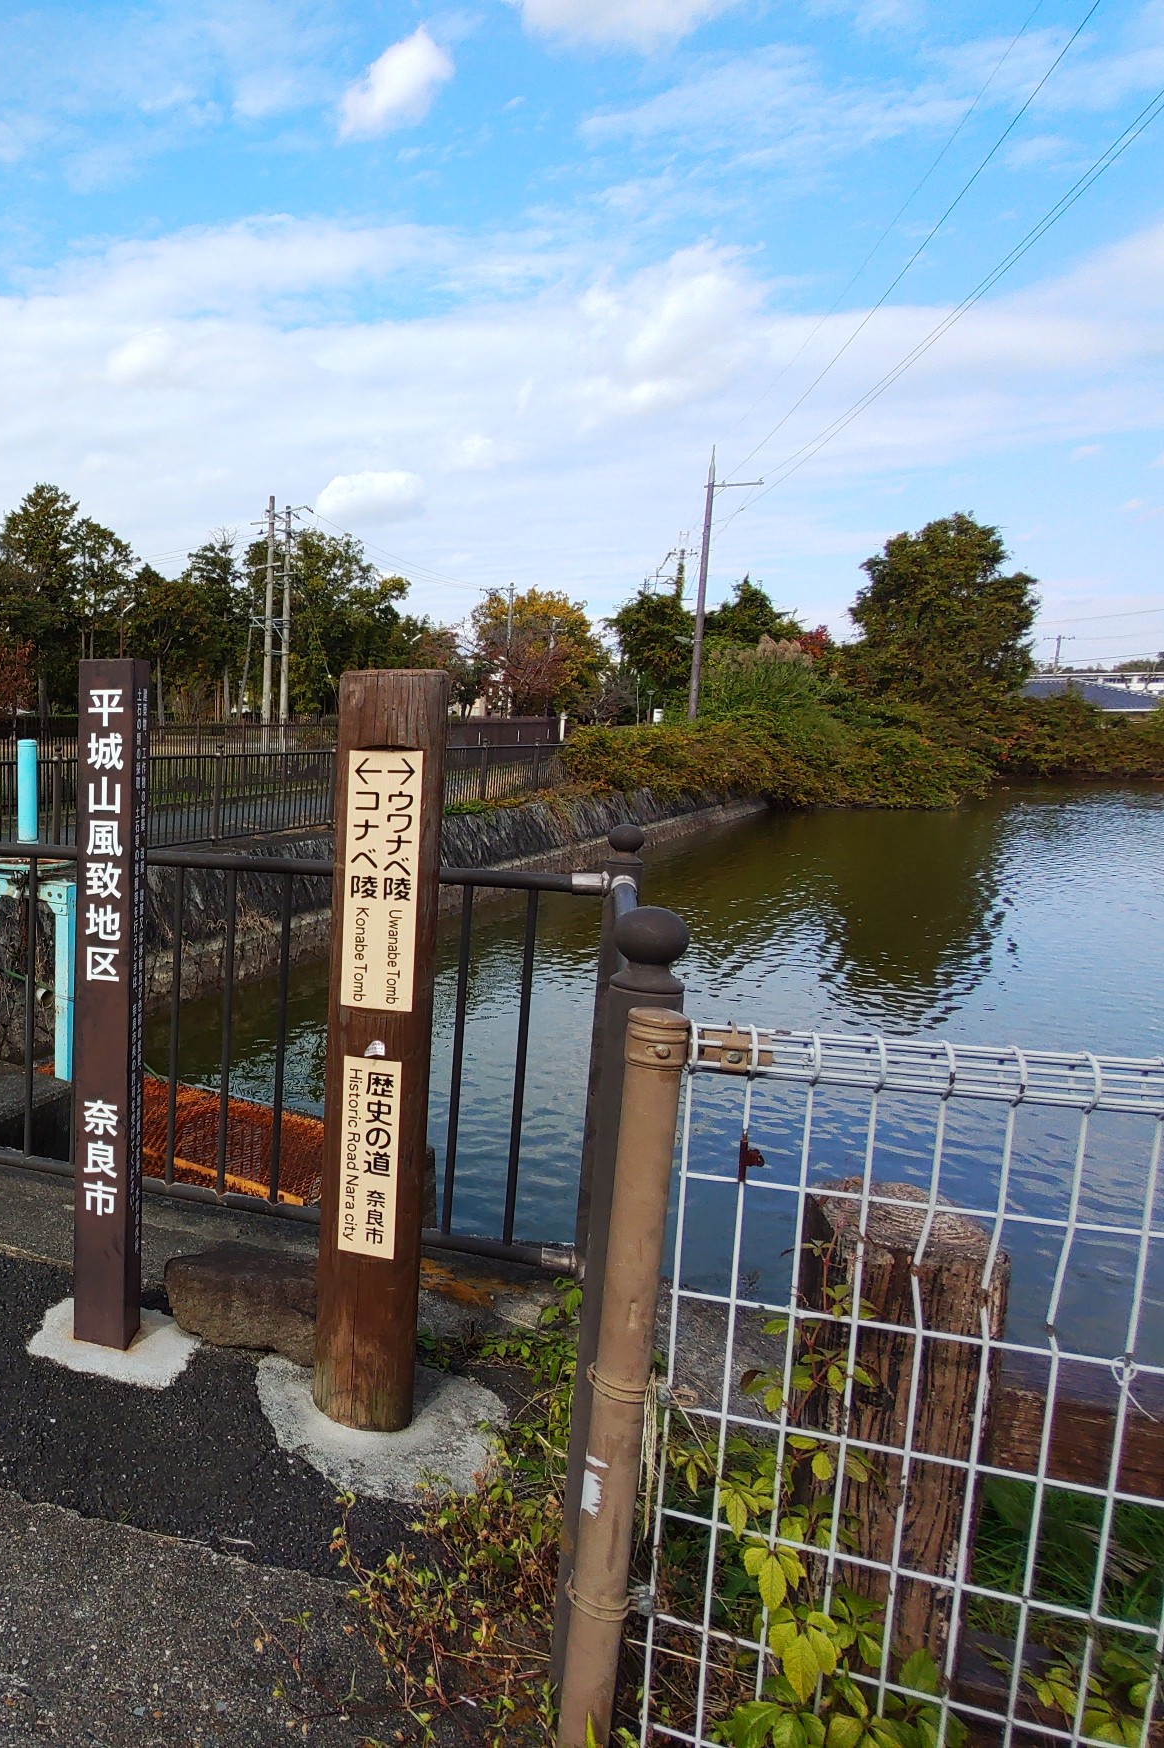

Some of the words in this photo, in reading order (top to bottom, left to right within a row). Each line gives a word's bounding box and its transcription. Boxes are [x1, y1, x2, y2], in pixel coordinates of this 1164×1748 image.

[85, 689, 124, 982] 平城山風致地区
[350, 791, 380, 900] コナベ陵
[383, 790, 413, 902] ウワナベ陵
[354, 907, 370, 961] Konabe
[387, 909, 403, 968] Uwanabe
[353, 963, 368, 1002] Tomb
[385, 970, 401, 1005] Tomb
[347, 1068, 363, 1129] Historic
[363, 1071, 394, 1178] 歴史の道
[83, 1099, 119, 1216] 奈良市
[346, 1131, 361, 1171] Road
[345, 1174, 359, 1210] Nara
[365, 1189, 386, 1245] 奈良市
[342, 1213, 358, 1242] city
